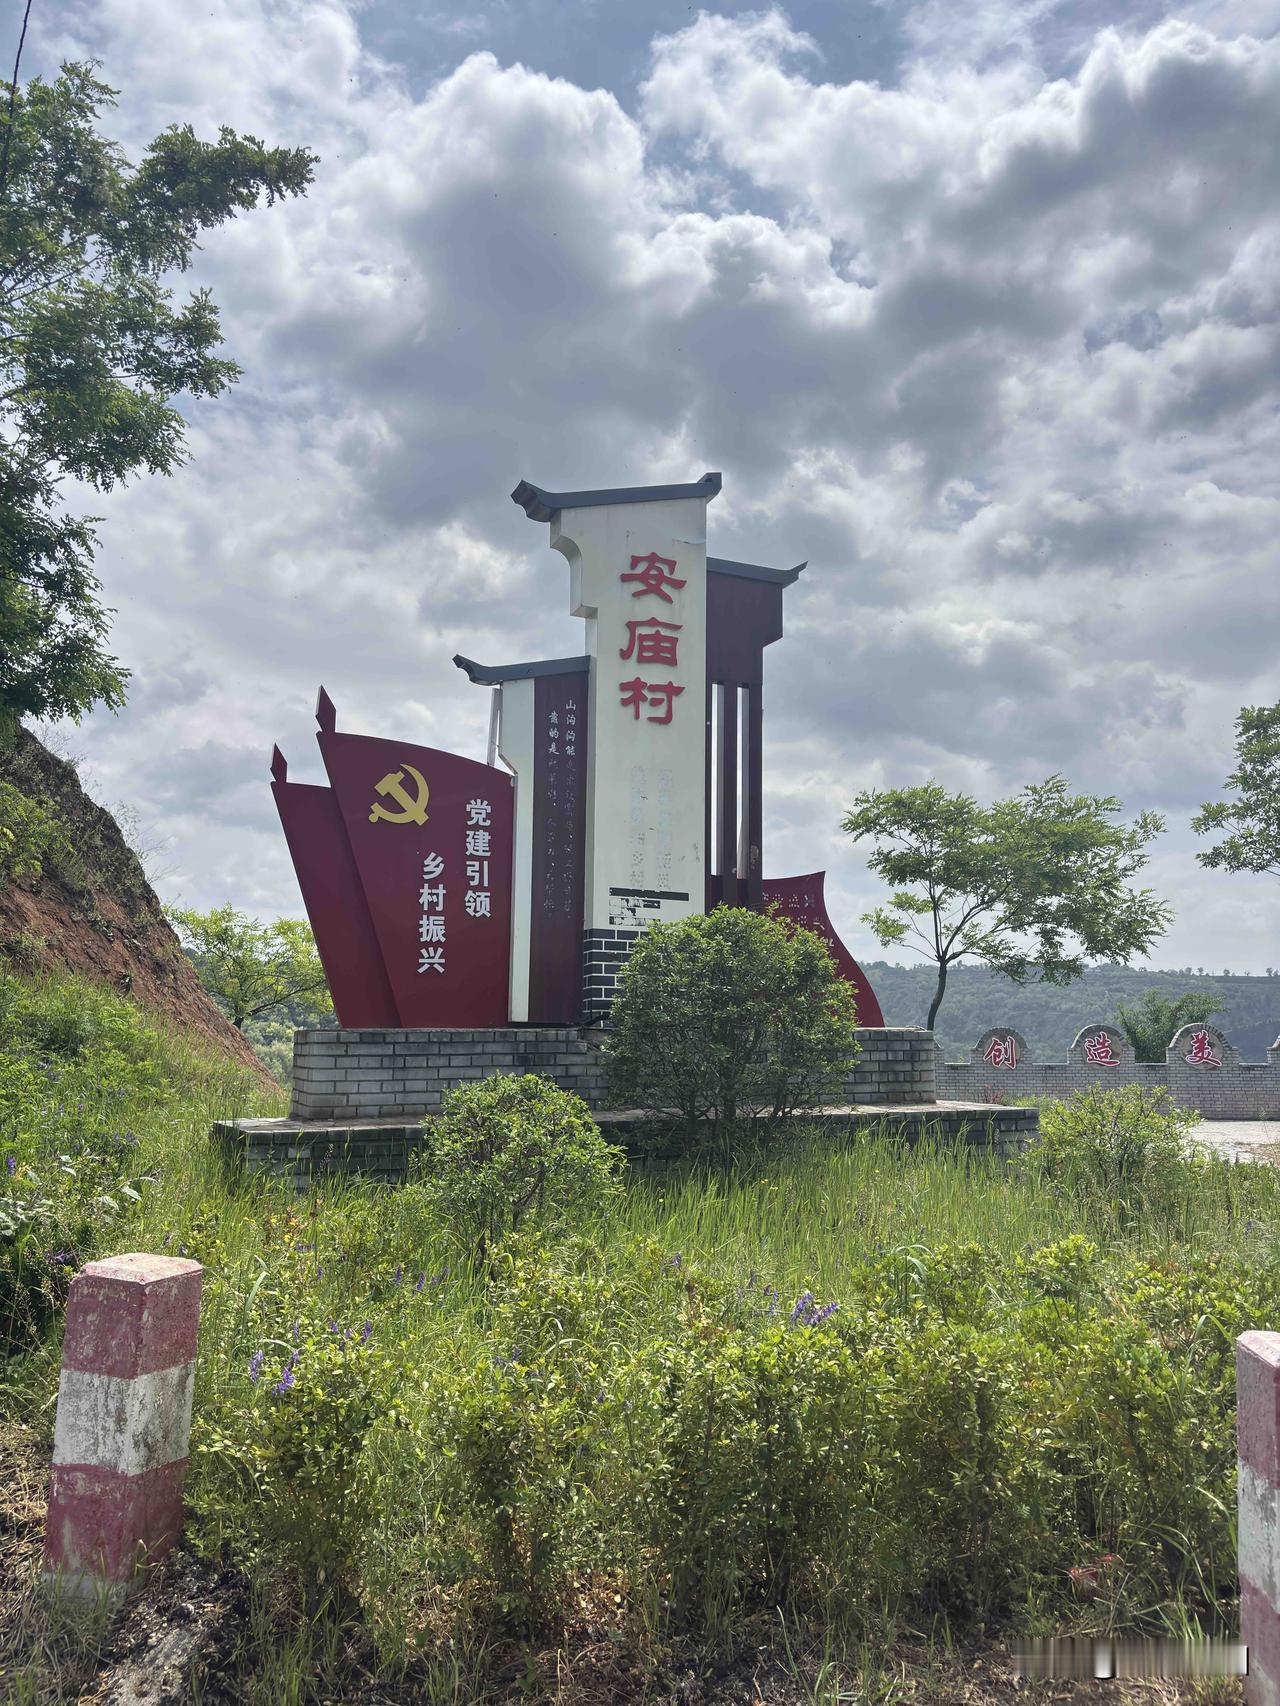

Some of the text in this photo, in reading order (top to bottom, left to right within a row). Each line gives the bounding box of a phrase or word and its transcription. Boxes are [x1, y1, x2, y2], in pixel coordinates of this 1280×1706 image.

[619, 552, 687, 725] 安庙村
[417, 852, 446, 973] 乡村振兴
[465, 799, 491, 918] 党建引领
